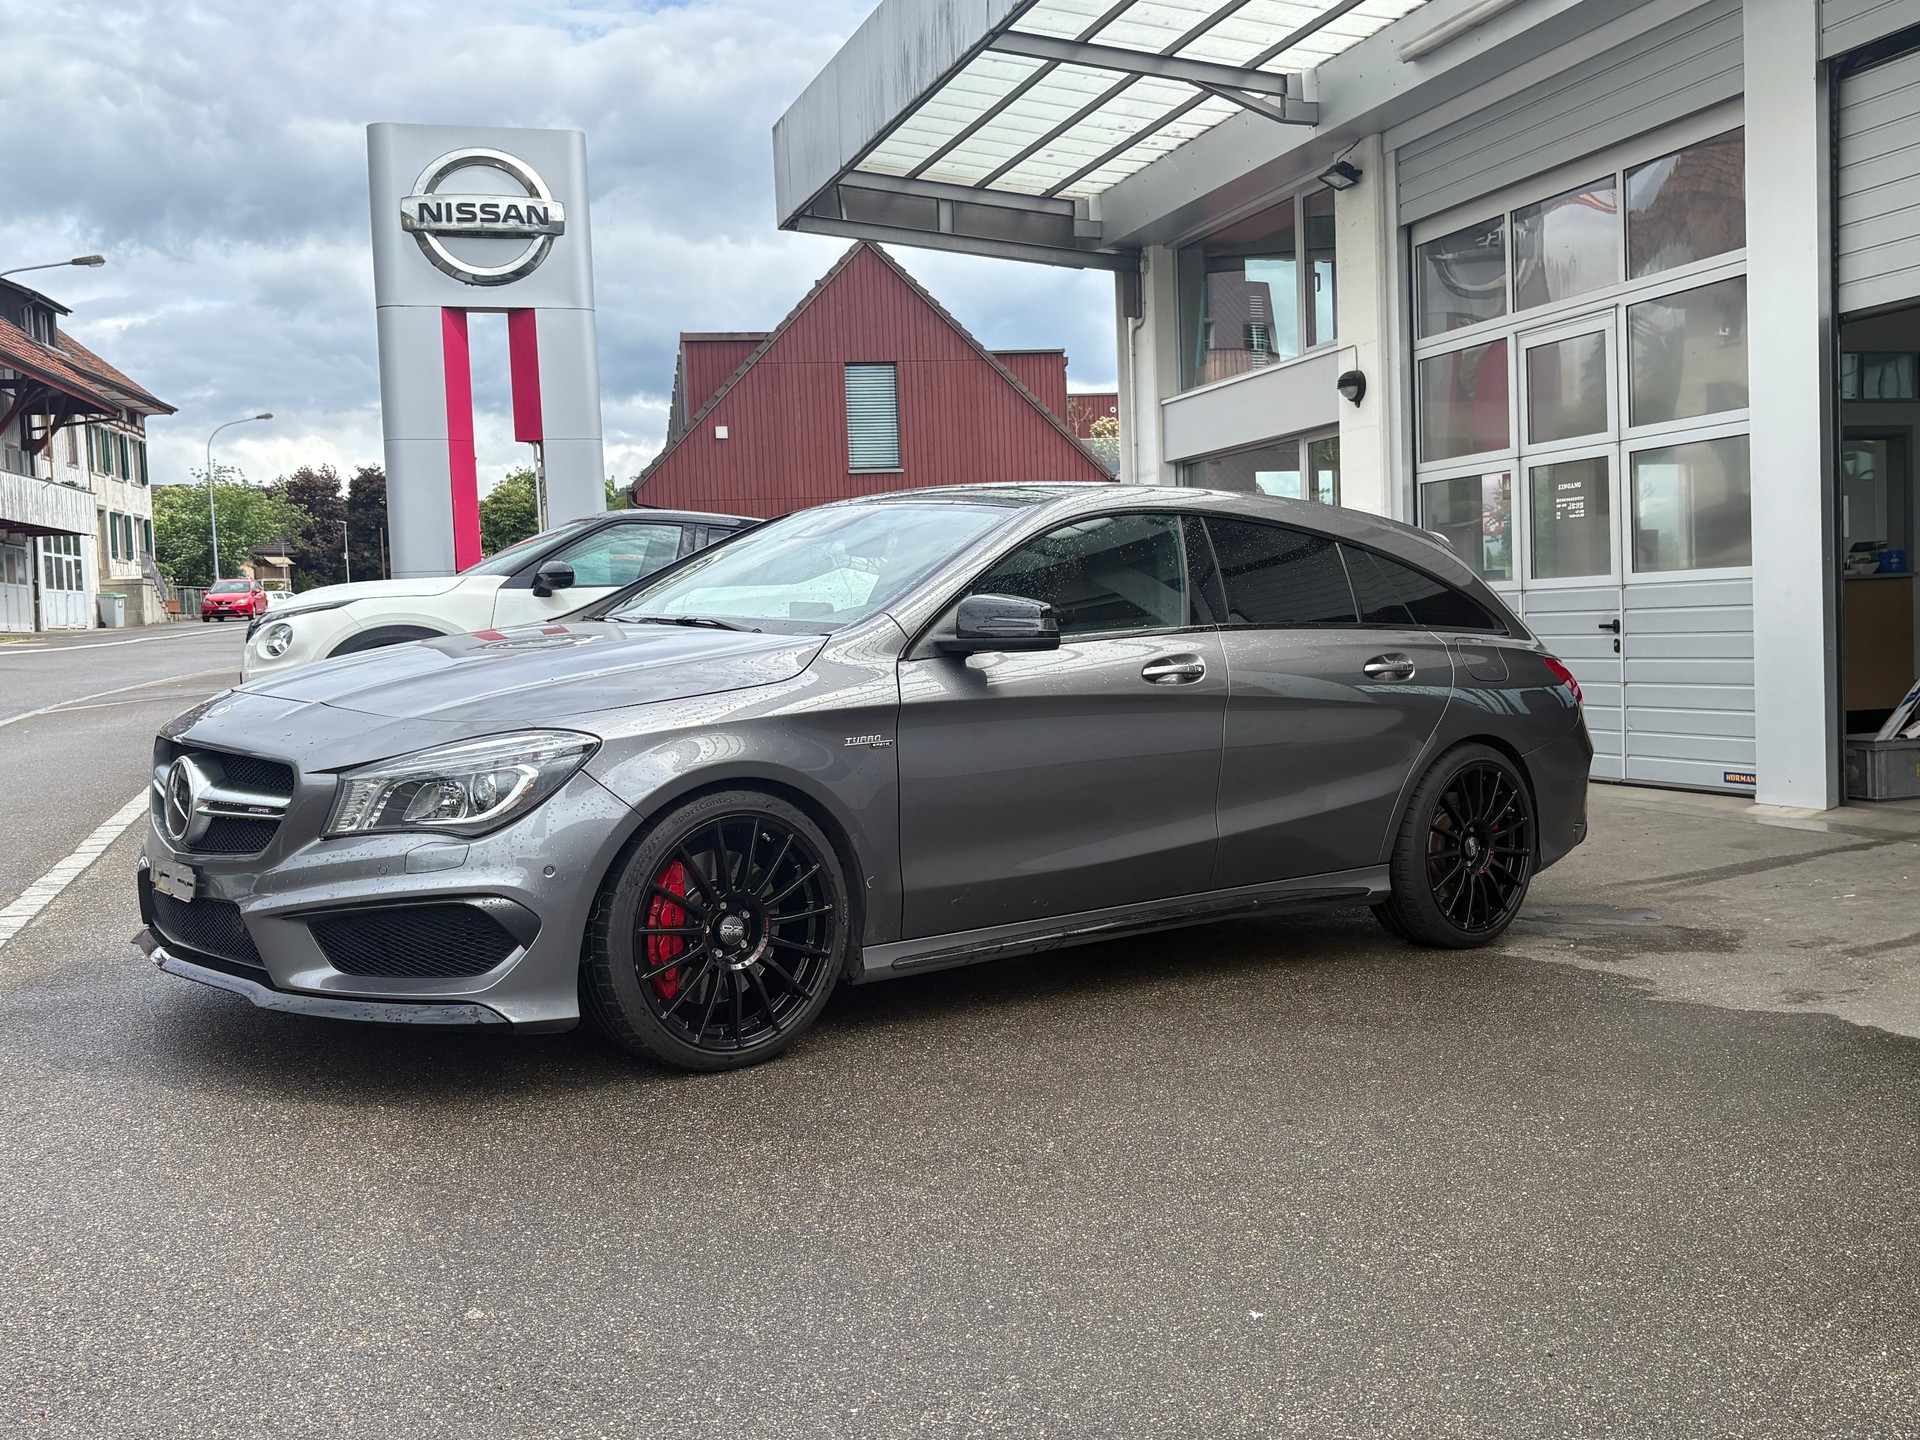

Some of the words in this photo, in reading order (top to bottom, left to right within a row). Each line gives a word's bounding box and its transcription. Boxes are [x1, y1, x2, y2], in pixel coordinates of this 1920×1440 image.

[418, 202, 549, 226] NISSAN
[845, 734, 882, 745] TURBO
[672, 795, 739, 827] SportContact
[722, 924, 744, 932] OZ
